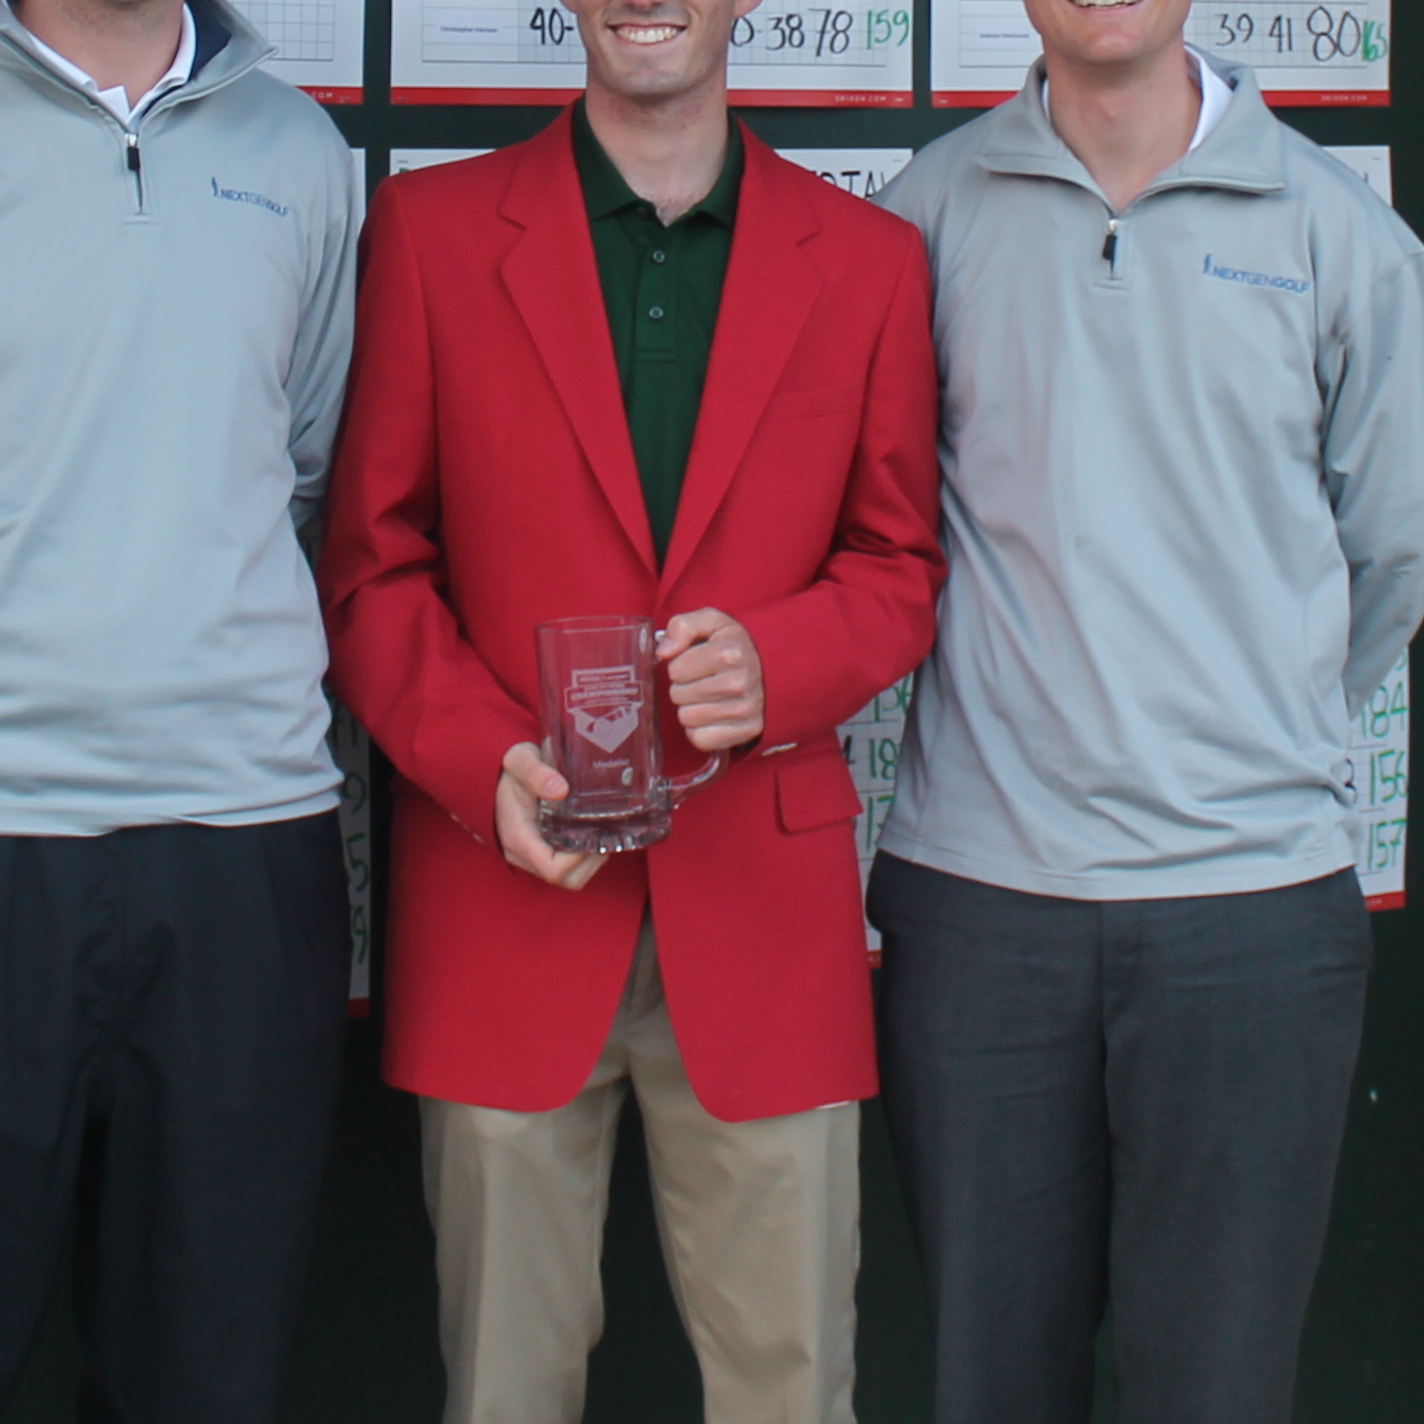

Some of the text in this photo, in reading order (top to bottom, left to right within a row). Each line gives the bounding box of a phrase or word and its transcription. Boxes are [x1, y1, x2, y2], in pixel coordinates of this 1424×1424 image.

[814, 9, 909, 57] 78 159
[1307, 6, 1361, 61] 80
